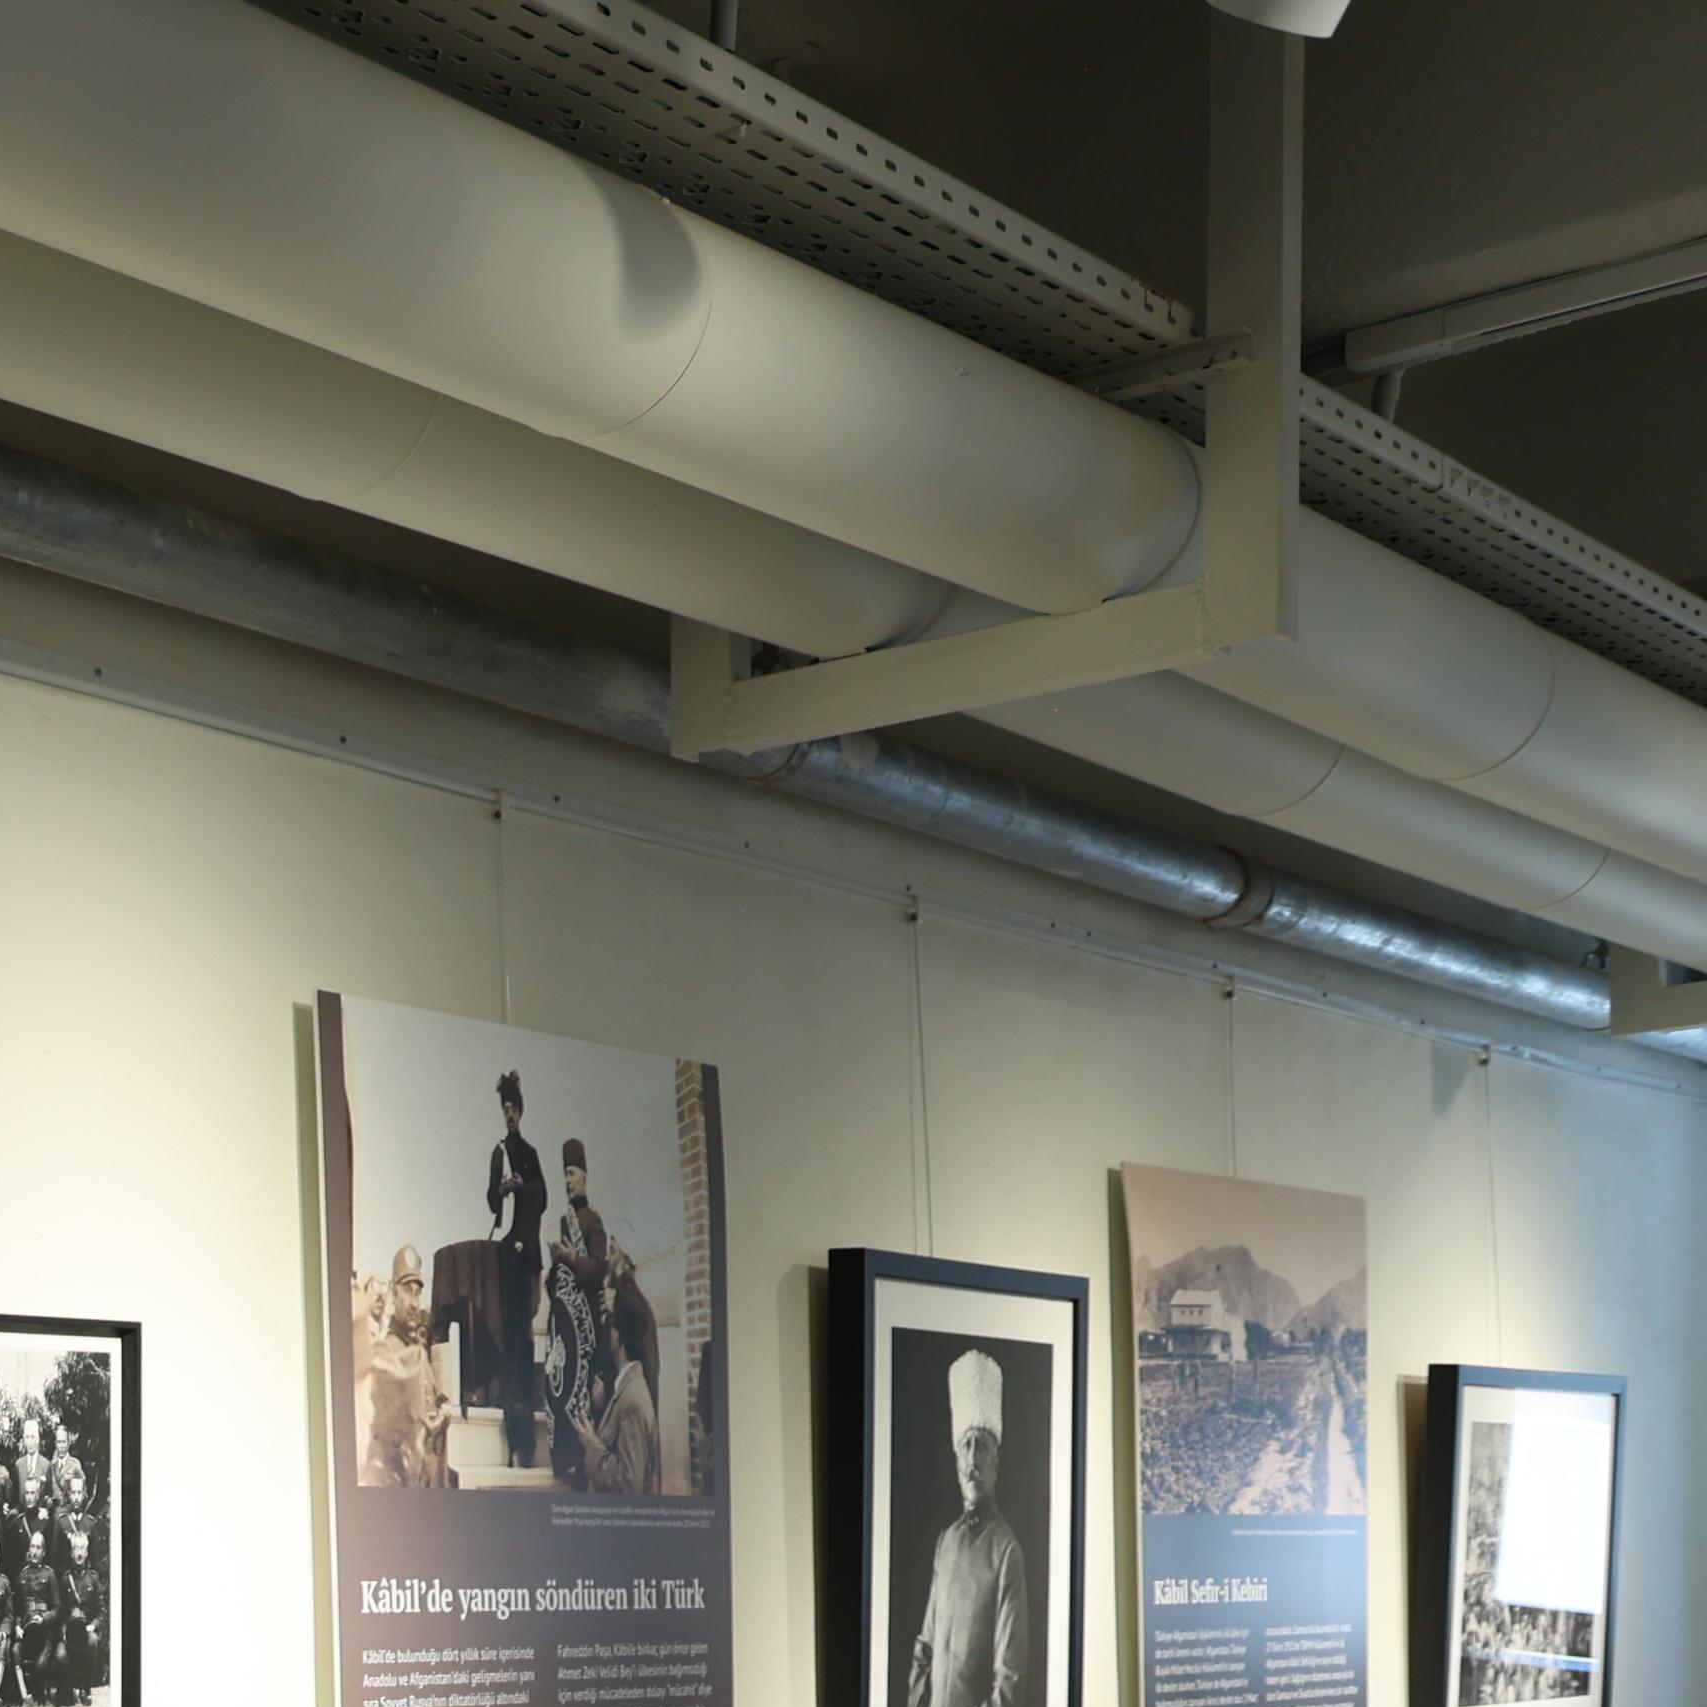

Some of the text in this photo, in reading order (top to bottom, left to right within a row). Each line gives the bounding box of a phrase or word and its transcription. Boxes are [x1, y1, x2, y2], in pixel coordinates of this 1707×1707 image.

[360, 1577, 704, 1620] Kâbil’de yangın söndüren iki Türk
[1191, 1578, 1229, 1603] Sefir-i
[1231, 1577, 1267, 1602] Kebiri
